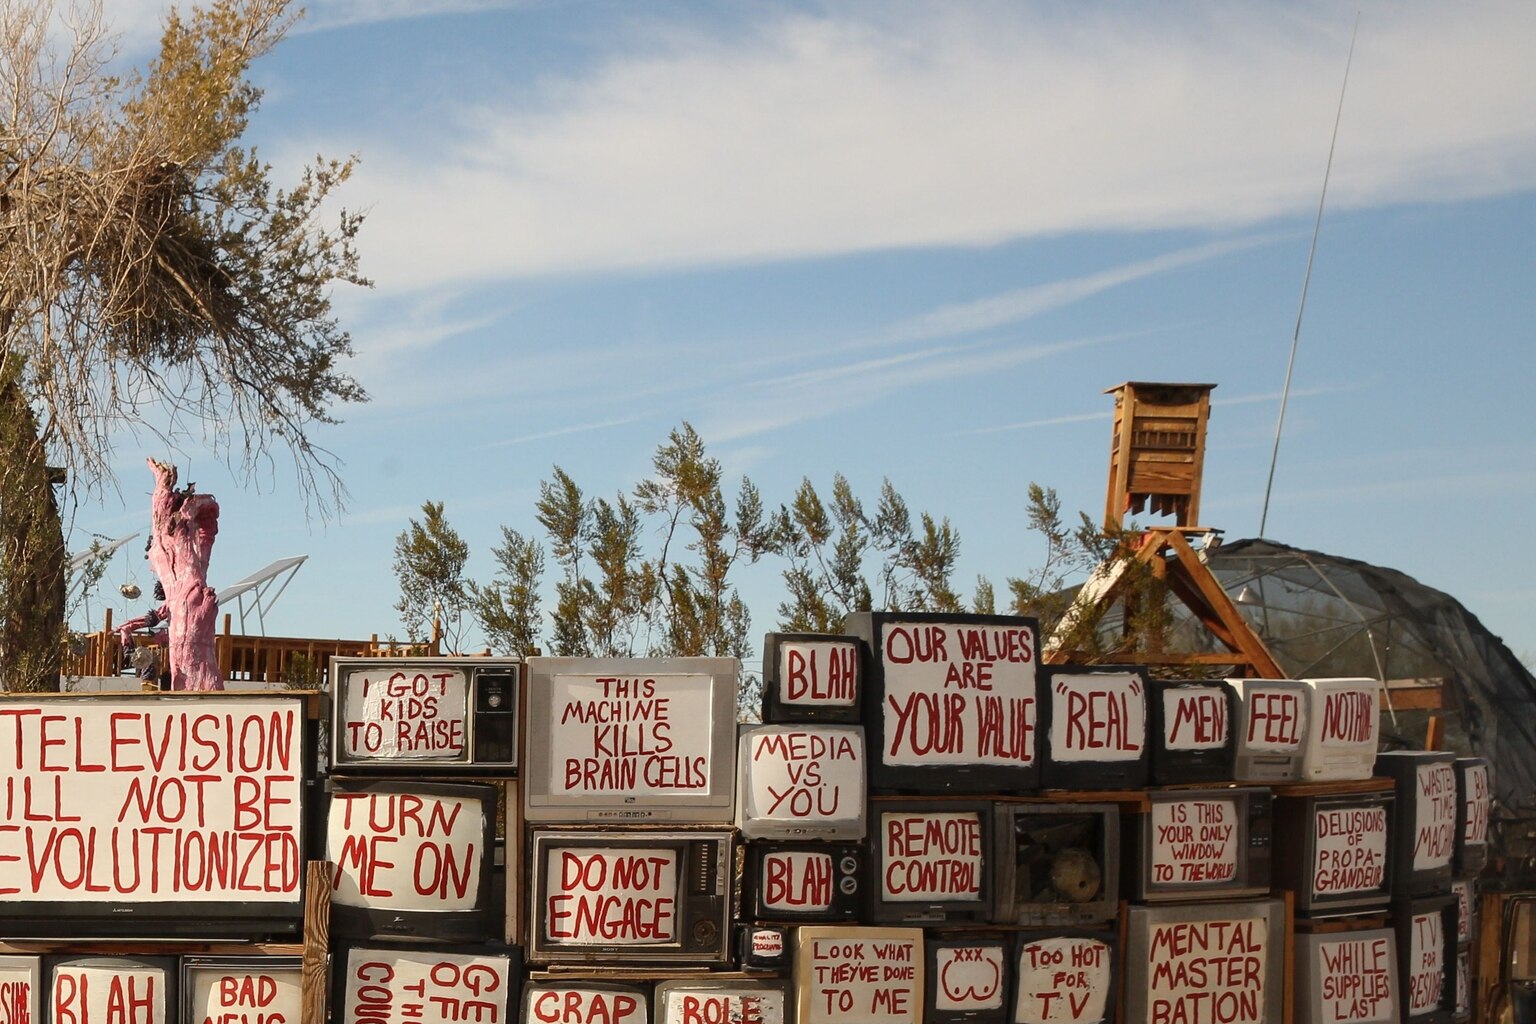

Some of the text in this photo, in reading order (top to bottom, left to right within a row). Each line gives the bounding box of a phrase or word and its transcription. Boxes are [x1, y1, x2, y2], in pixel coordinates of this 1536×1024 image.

[595, 677, 656, 698] THIS
[561, 698, 670, 725] MACHINE
[1056, 680, 1140, 751] "REAL"
[1169, 695, 1224, 744] MEN
[1248, 693, 1299, 744] FEEL
[1321, 692, 1372, 743] NOTHING
[0, 709, 294, 773] TELEVISION
[593, 721, 673, 758] KILLS
[755, 733, 856, 761] MEDIA
[564, 755, 707, 791] BRAIN CELLS
[787, 761, 827, 787] VS.
[118, 775, 221, 828] NOT
[234, 776, 294, 831] BE
[767, 786, 839, 816] YOU
[1171, 803, 1223, 823] IS THIS
[888, 818, 981, 856] REMOTE
[1158, 825, 1232, 844] YOUR ONLY
[1318, 811, 1384, 839] DELUSIONS
[1171, 844, 1225, 860] WINDOW
[1347, 834, 1363, 845] OF
[1154, 864, 1173, 881] TO
[1181, 864, 1204, 880] THE
[1319, 850, 1381, 869] PROPA-
[765, 856, 833, 906] BLAH
[886, 859, 979, 894] CONTROL
[1315, 865, 1382, 891] GRANDEUR
[814, 942, 913, 962] LOOK WHAT
[1150, 921, 1261, 961] MENTAL
[1026, 945, 1106, 968] TOO HOT
[1321, 940, 1386, 974] WHILE
[814, 961, 914, 983] THEY'VE DONE
[1053, 972, 1088, 989] FOR
[1152, 957, 1261, 991] MASTER
[1323, 974, 1389, 1000] SUPPLIES
[822, 989, 910, 1014] TO ME
[1335, 999, 1378, 1021] LAST
